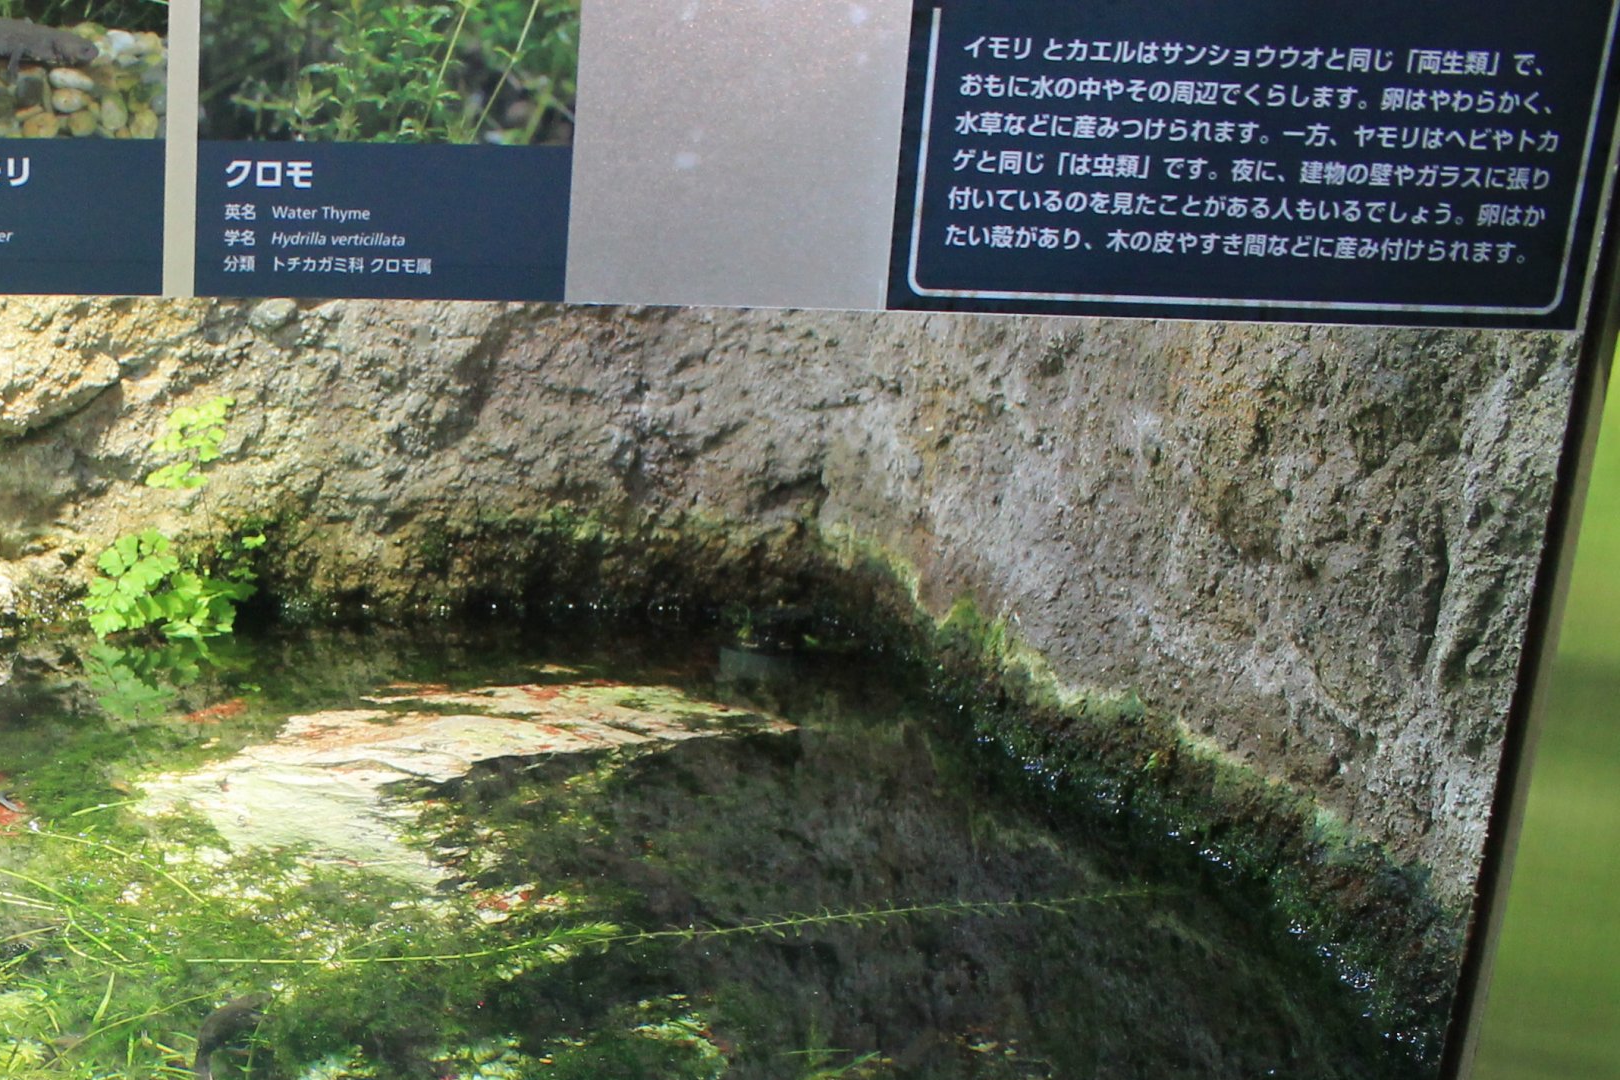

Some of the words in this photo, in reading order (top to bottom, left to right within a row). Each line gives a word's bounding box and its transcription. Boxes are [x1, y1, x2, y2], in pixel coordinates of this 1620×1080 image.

[225, 159, 314, 189] クロモ
[225, 203, 257, 221] 英名
[272, 206, 318, 220] Water
[322, 206, 372, 224] Thyme
[224, 229, 256, 247] 学名
[271, 231, 327, 249] Hydrilla
[331, 232, 407, 247] verticillata
[223, 255, 256, 273] 分類
